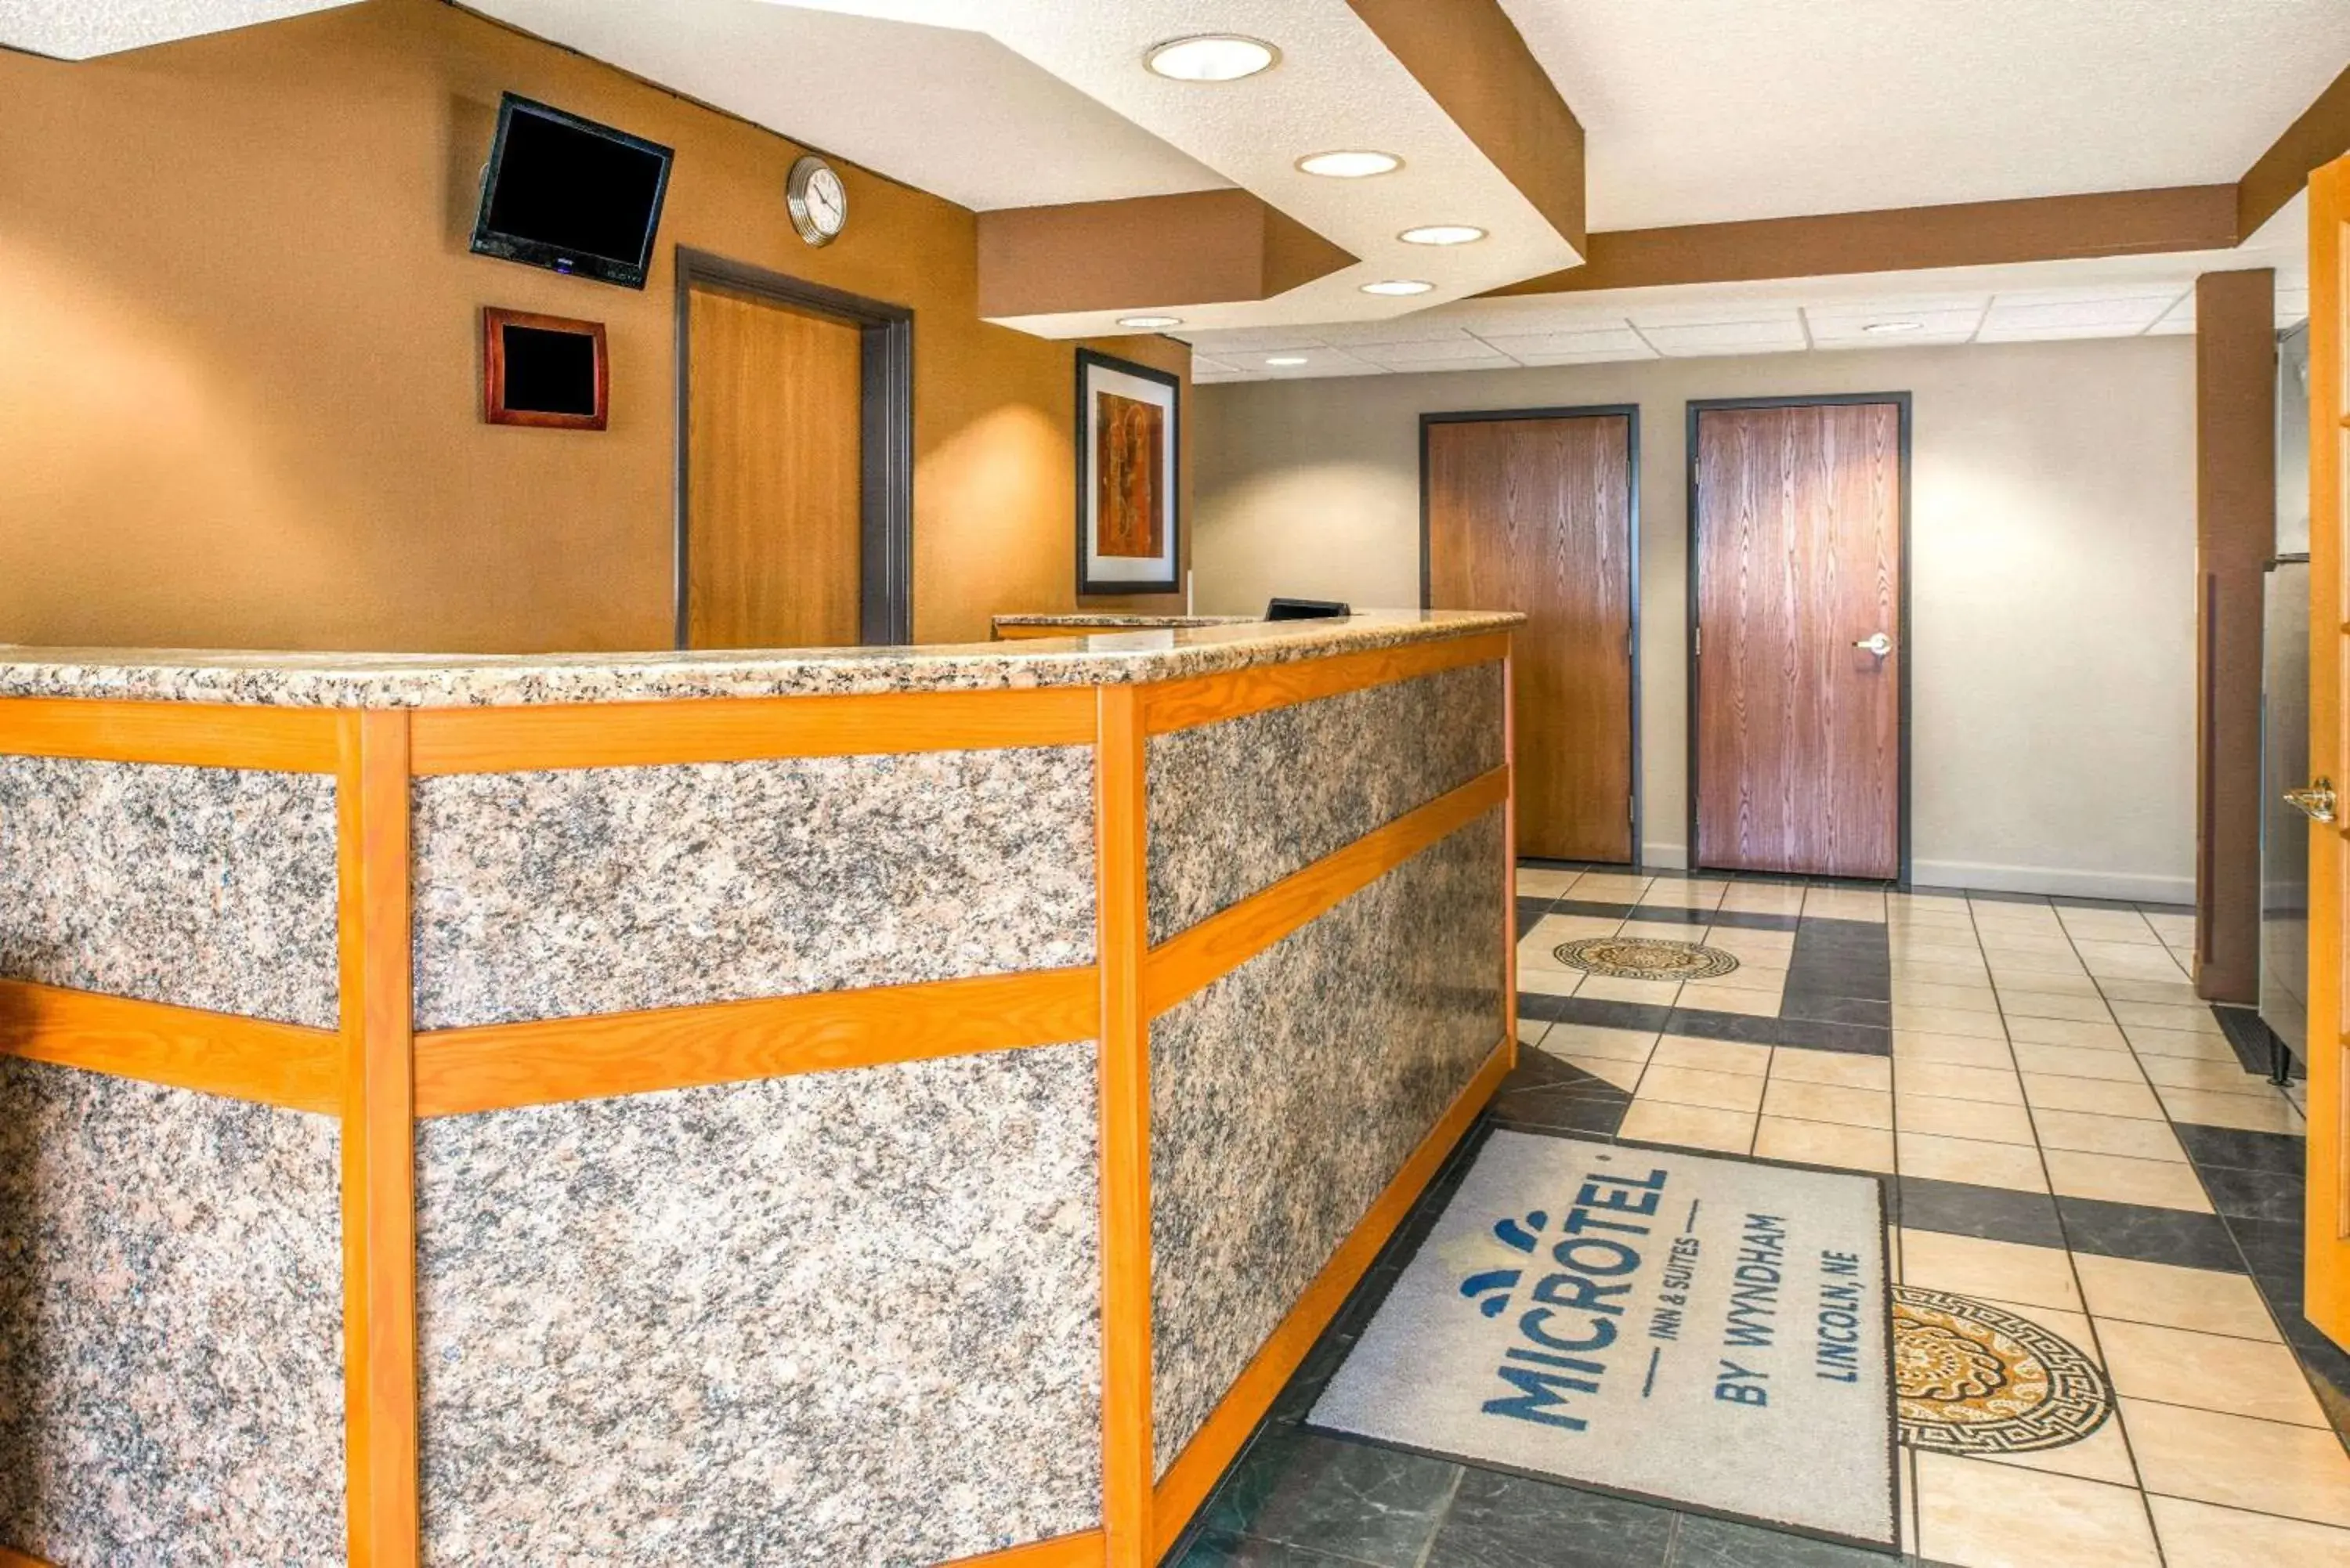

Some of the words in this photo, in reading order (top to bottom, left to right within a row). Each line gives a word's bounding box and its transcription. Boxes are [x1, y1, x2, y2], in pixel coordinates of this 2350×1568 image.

[1662, 1237, 1699, 1290] SUITES
[1723, 1213, 1787, 1346] WYNDHAM
[1820, 1250, 1859, 1276] NE
[1481, 1169, 1667, 1431] MICROTEL
[1648, 1307, 1683, 1341] INN
[1658, 1294, 1687, 1306] &
[1816, 1282, 1865, 1382] LINCOLN,
[1715, 1359, 1769, 1407] BY
